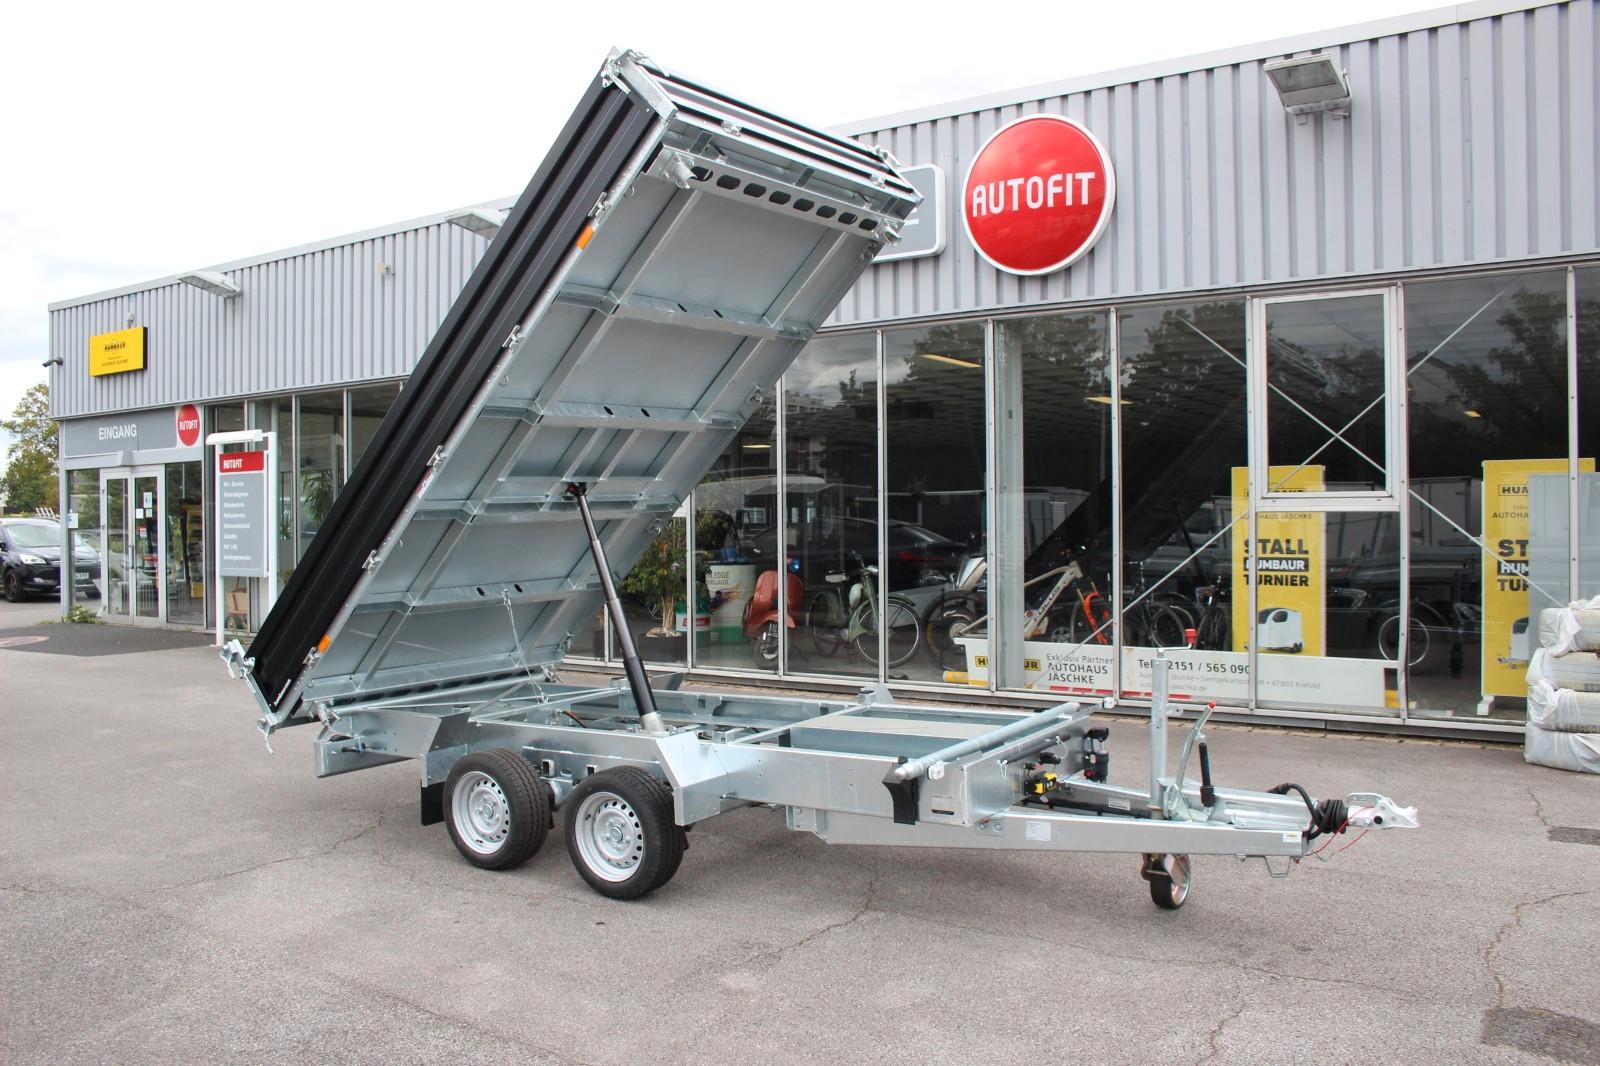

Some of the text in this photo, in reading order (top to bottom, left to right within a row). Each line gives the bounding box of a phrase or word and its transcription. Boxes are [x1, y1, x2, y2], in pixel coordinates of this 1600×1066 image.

[972, 172, 1095, 217] AUTOFIT
[179, 420, 198, 430] AUTOFIT
[98, 423, 137, 440] EINGANG
[223, 458, 243, 469] AUTOFIT
[1048, 662, 1108, 675] AUTOHAUS
[1206, 663, 1226, 673] 565
